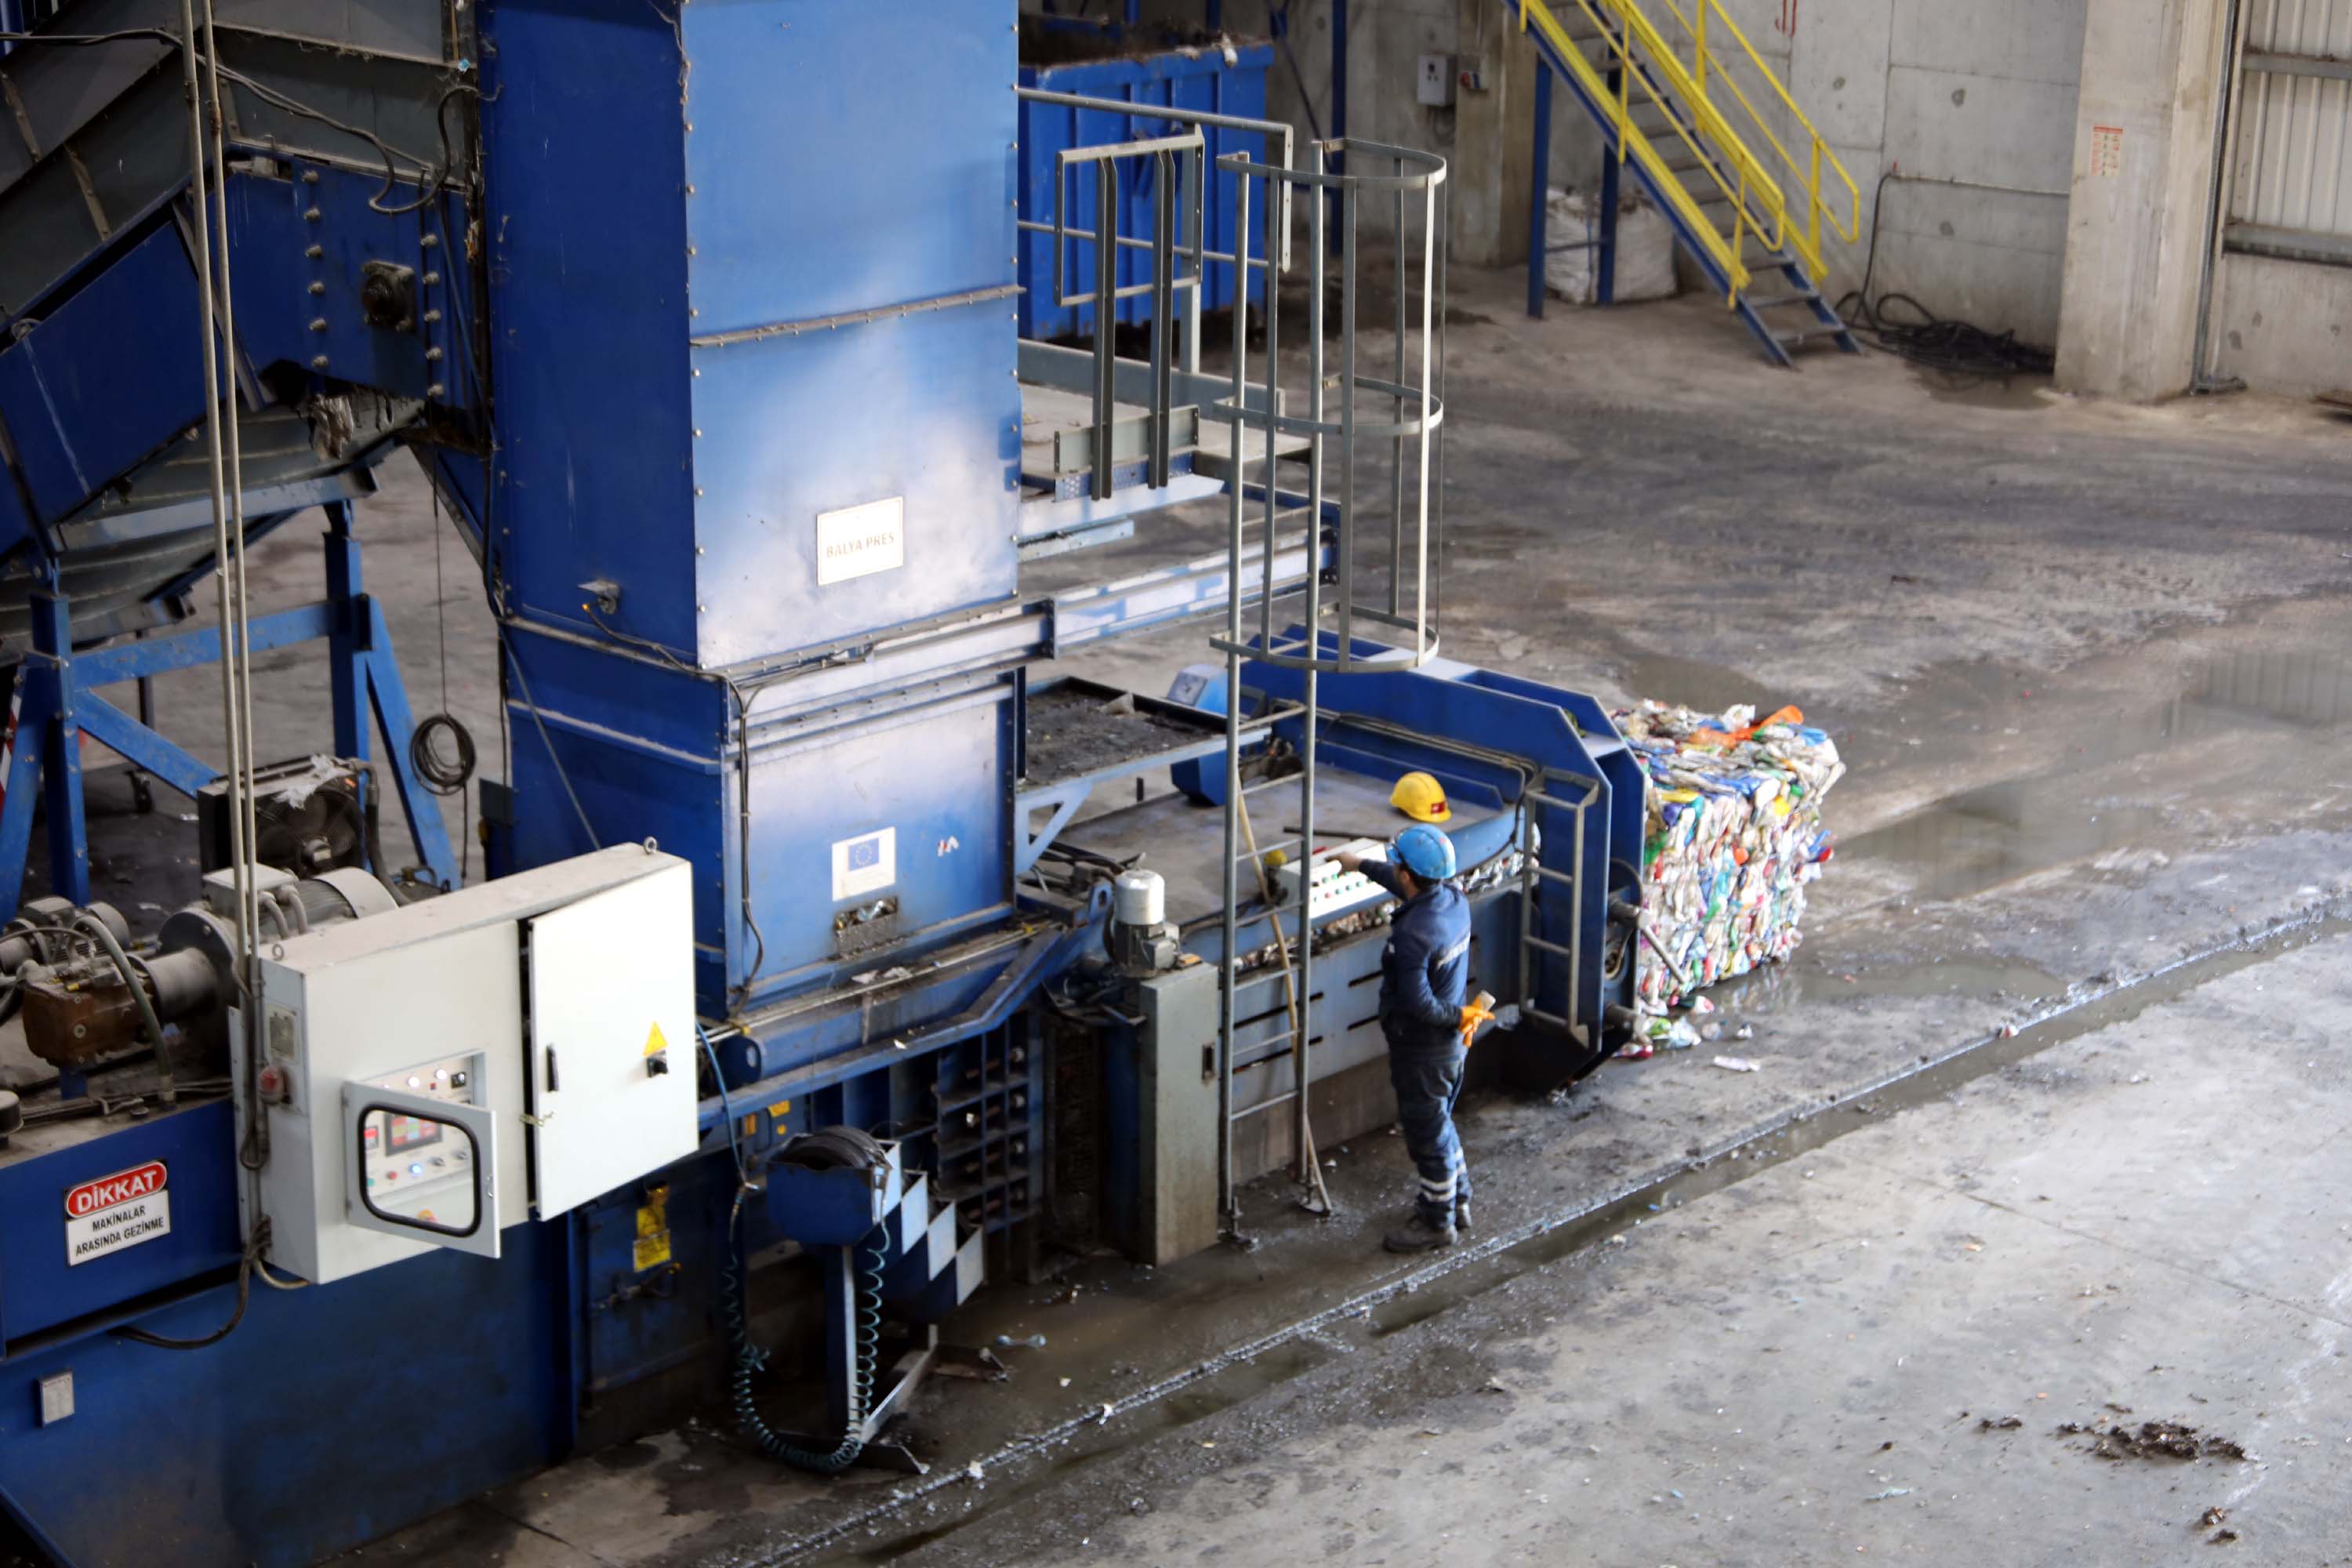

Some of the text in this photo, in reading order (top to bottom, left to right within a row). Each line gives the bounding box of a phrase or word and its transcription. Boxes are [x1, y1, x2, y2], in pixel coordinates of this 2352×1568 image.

[826, 532, 895, 559] BALYA PRES
[76, 1170, 158, 1213] DİKKAT
[92, 1205, 146, 1232] MAKİNALAR
[75, 1217, 165, 1257] ARASINDA GEZİNME
